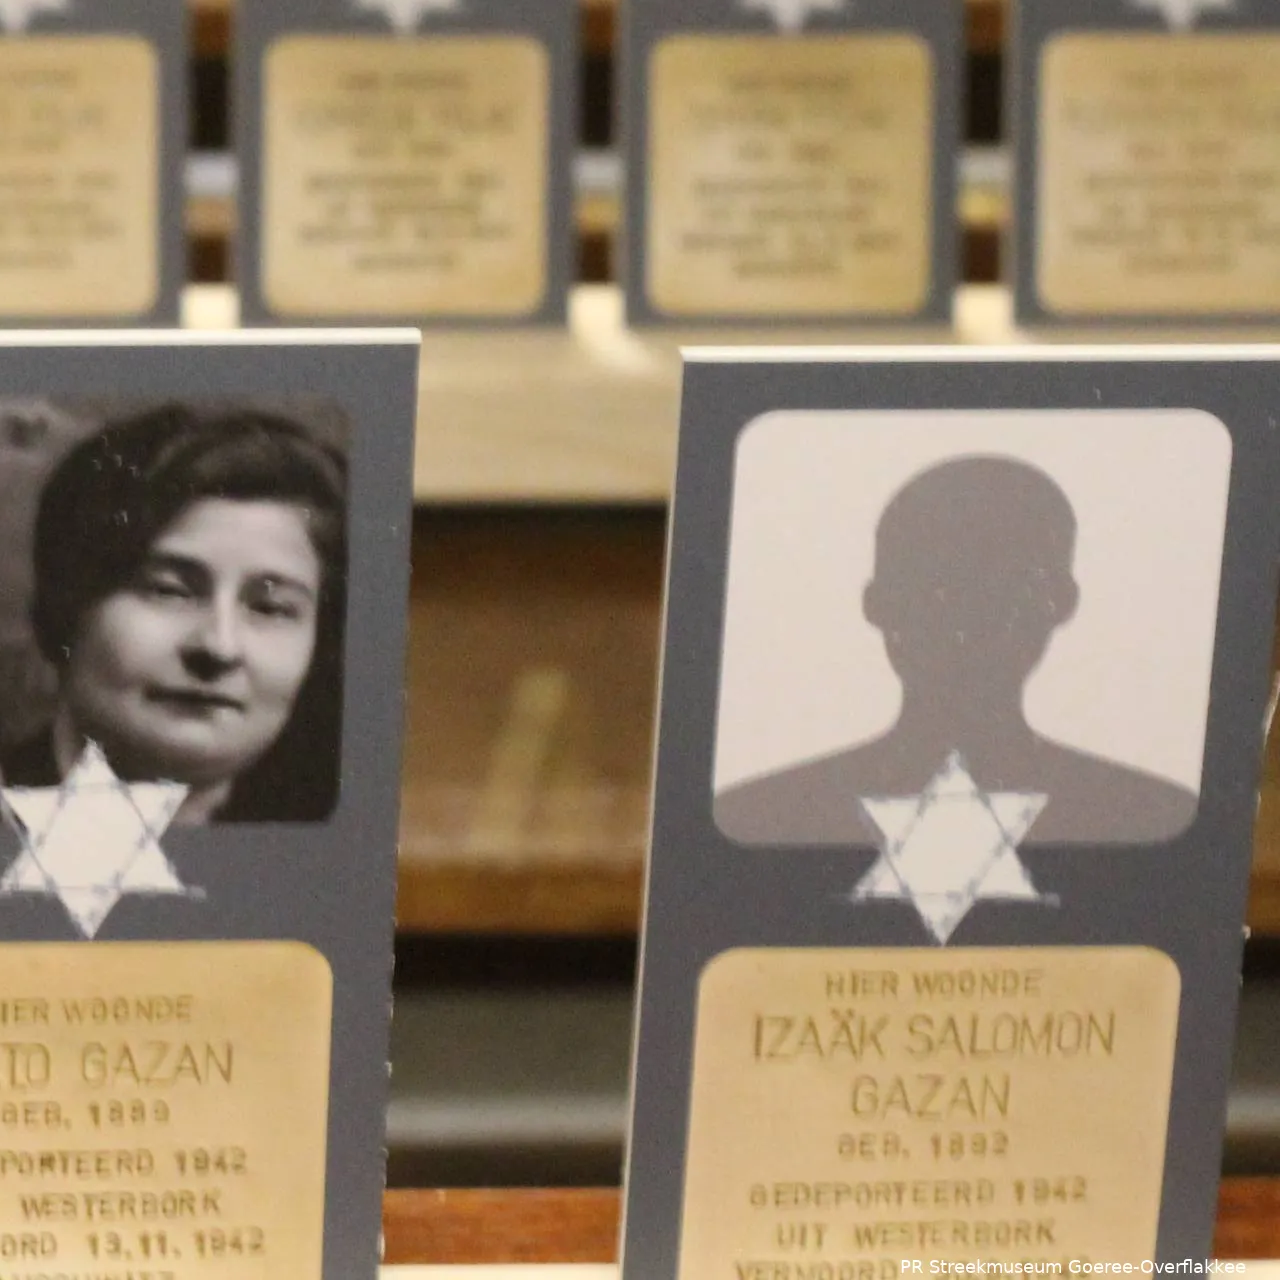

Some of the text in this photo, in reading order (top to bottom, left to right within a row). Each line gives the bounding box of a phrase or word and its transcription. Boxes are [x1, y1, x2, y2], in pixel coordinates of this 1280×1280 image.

[824, 969, 1043, 1001] HIER WOONDE
[62, 995, 194, 1025] WOONDE
[753, 1008, 1115, 1061] IZAÄK SALOMON
[80, 1040, 235, 1086] GAZAN
[851, 1074, 1011, 1120] GAZAN
[171, 1147, 249, 1177] 1942
[20, 1189, 222, 1220] WESTERBORK
[749, 1177, 996, 1210] GEDEPORTEERD
[776, 1219, 1057, 1251] UIT WESTERBORK
